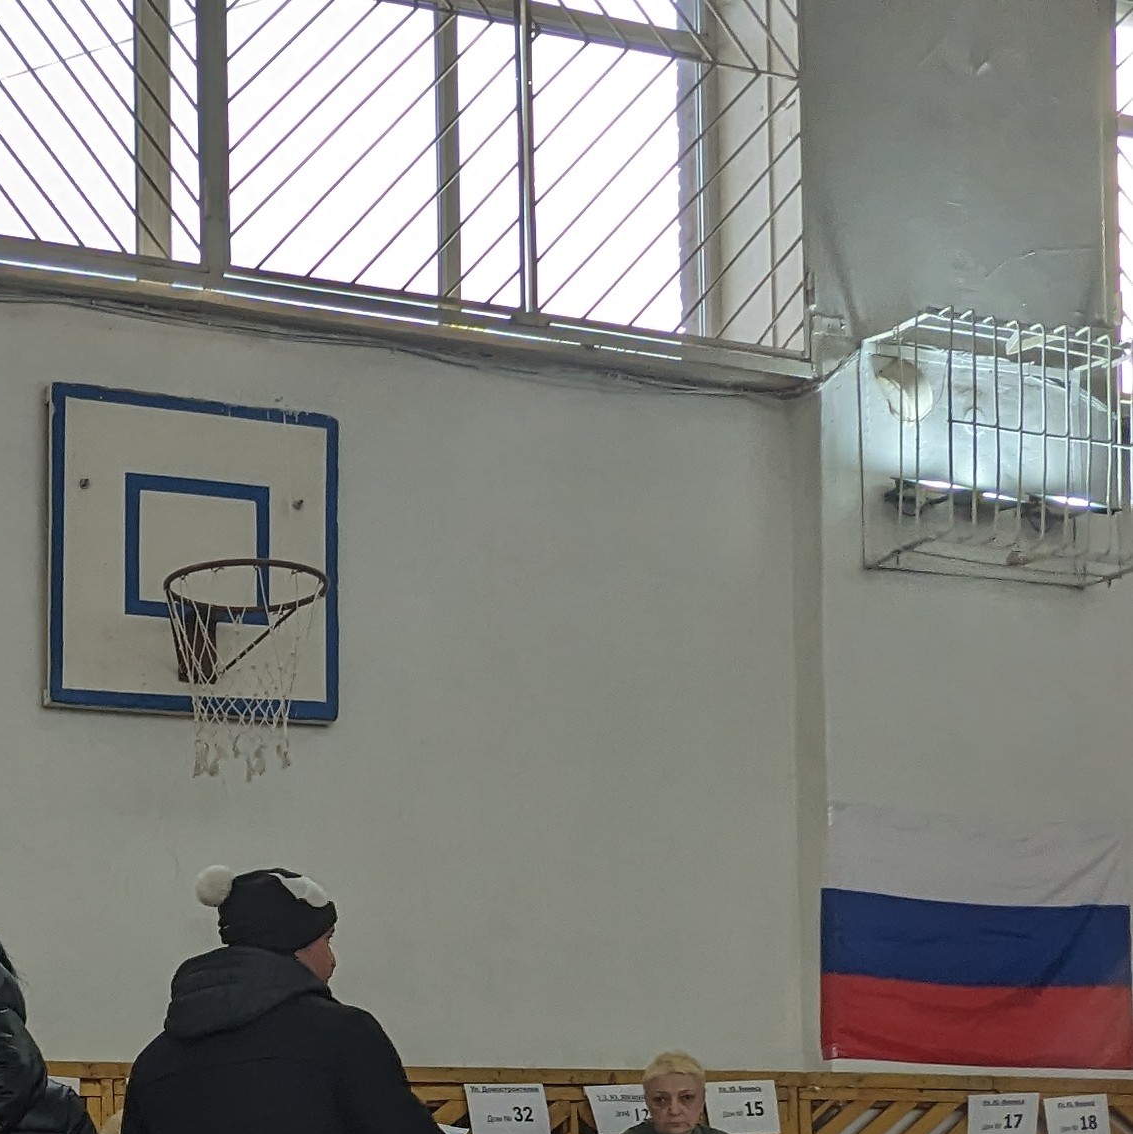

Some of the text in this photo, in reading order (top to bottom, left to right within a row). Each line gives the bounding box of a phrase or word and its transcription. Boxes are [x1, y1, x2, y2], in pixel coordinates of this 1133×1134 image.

[512, 1106, 534, 1122] 32
[745, 1101, 764, 1117] 15
[1003, 1113, 1023, 1129] 17
[1080, 1114, 1098, 1130] 18
